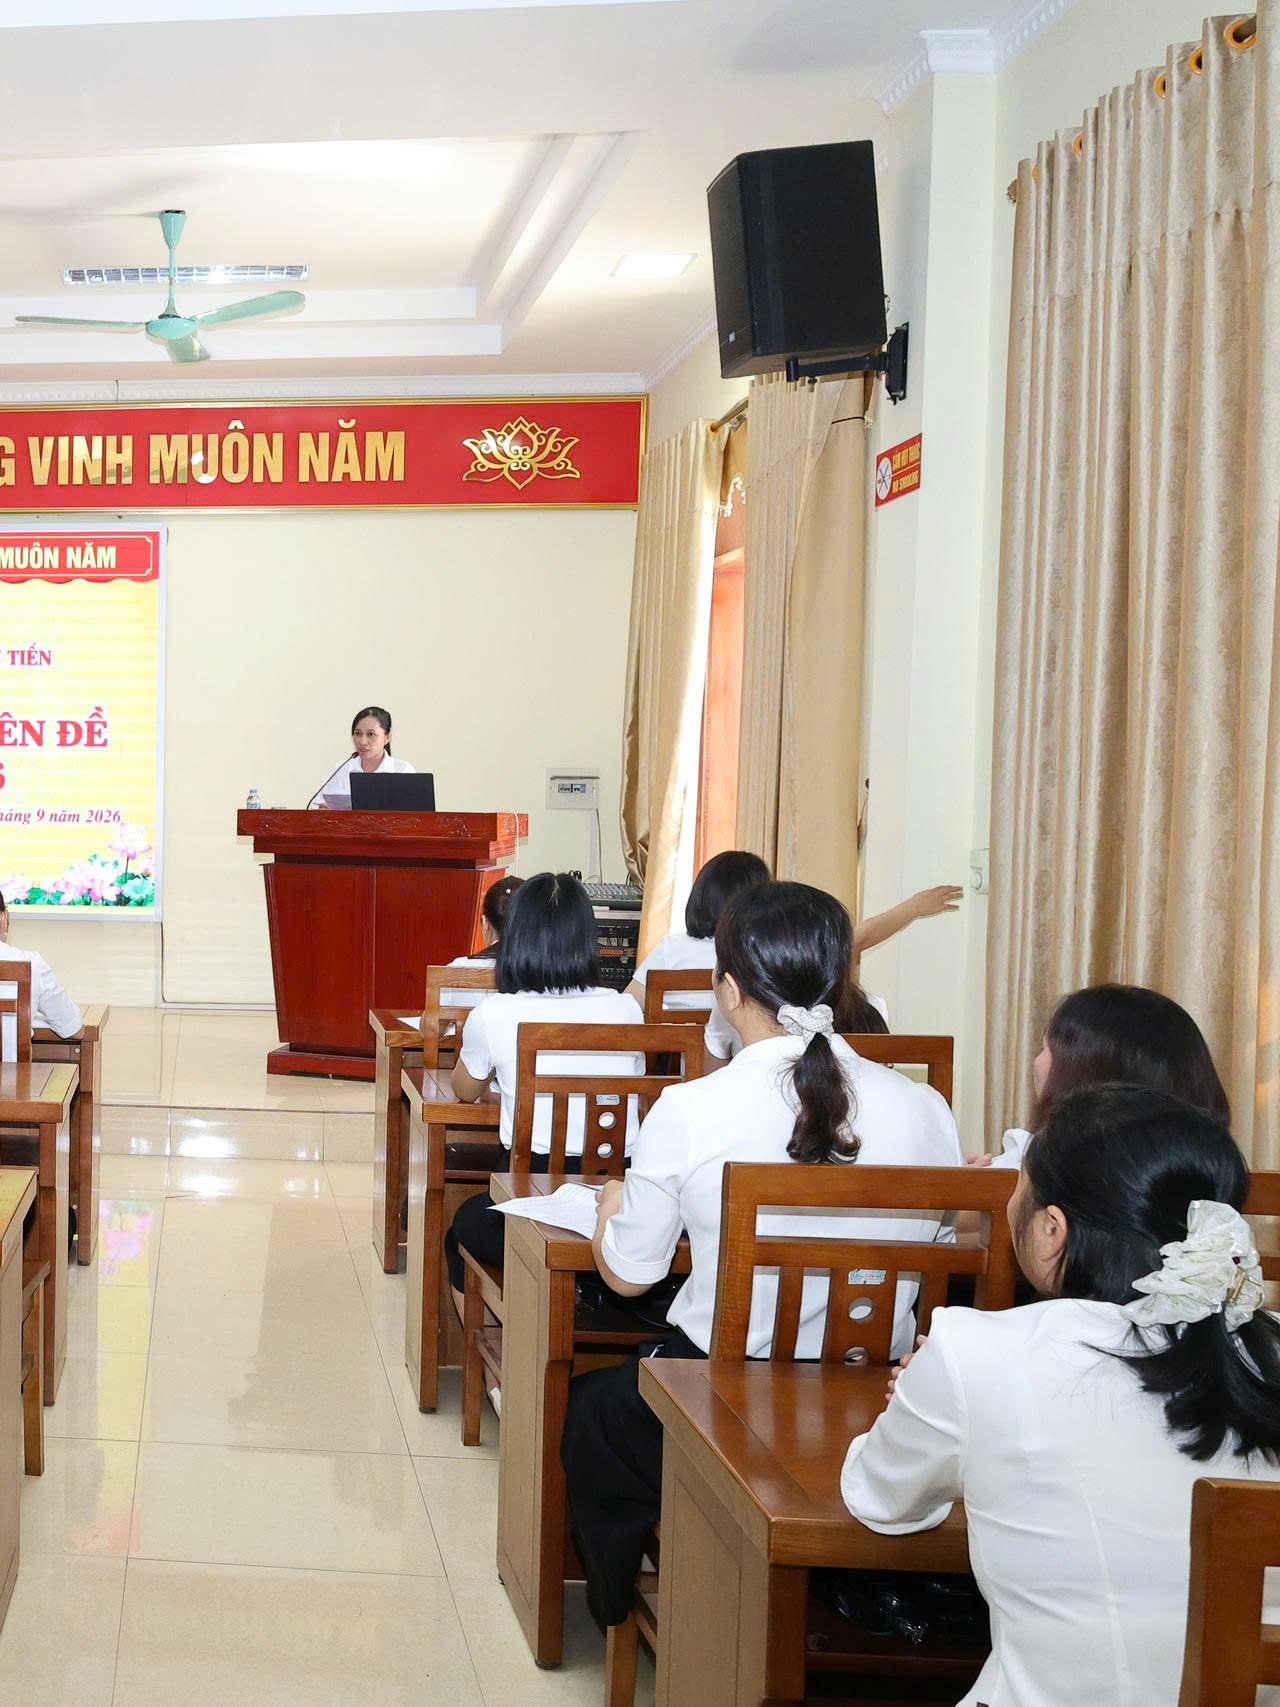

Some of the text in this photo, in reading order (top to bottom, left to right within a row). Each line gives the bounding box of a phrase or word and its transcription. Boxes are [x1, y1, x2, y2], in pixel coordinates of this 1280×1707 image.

[28, 435, 132, 486] VINH
[149, 420, 283, 485] MUÔN
[299, 419, 405, 483] NĂM
[66, 542, 117, 569] NĂM
[7, 642, 52, 665] TIẾN
[56, 706, 108, 747] ĐỀ
[36, 809, 45, 822] 9
[49, 810, 80, 823] năm
[85, 809, 121, 823] 2026
